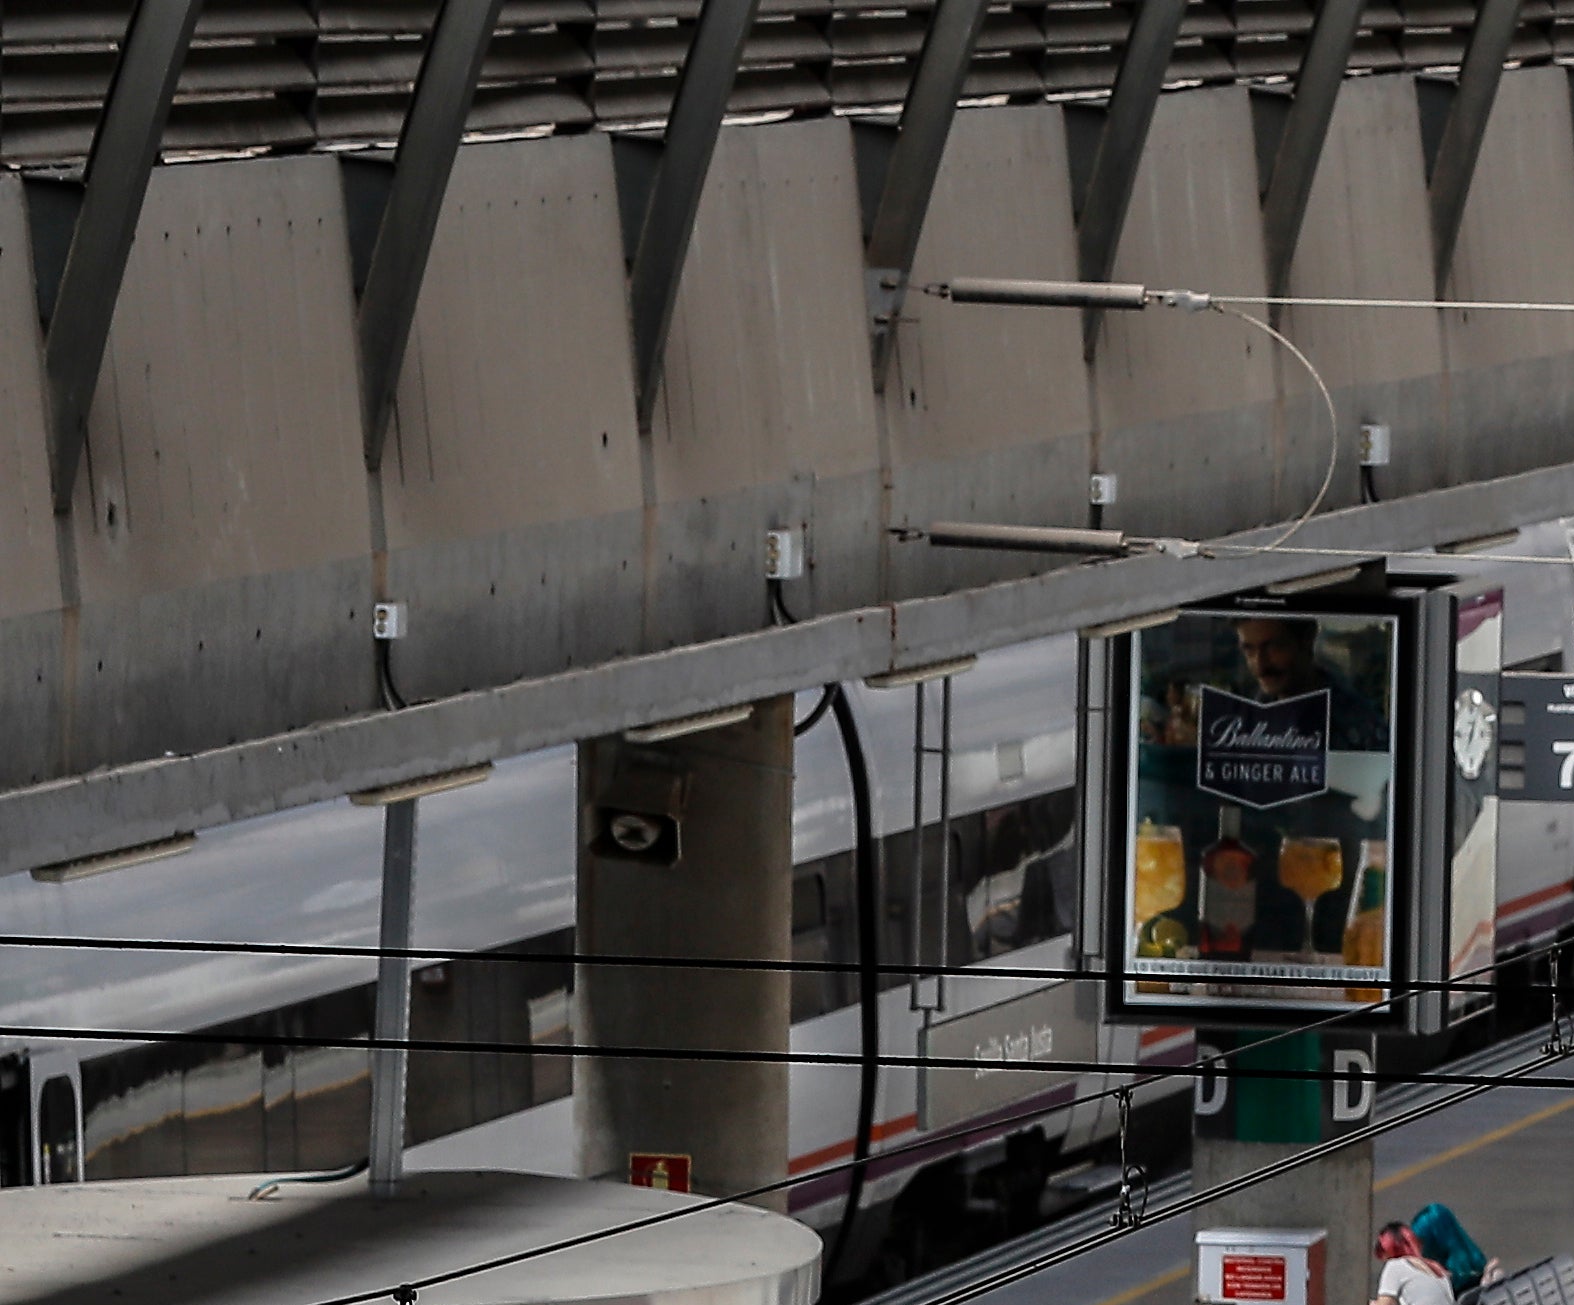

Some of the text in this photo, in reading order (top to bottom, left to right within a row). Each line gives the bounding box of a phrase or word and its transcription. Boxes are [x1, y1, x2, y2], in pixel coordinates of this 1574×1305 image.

[1221, 763, 1283, 783] GINGER
[1290, 764, 1321, 785] ALE
[1194, 1044, 1228, 1116] D
[1332, 1049, 1375, 1121] D
